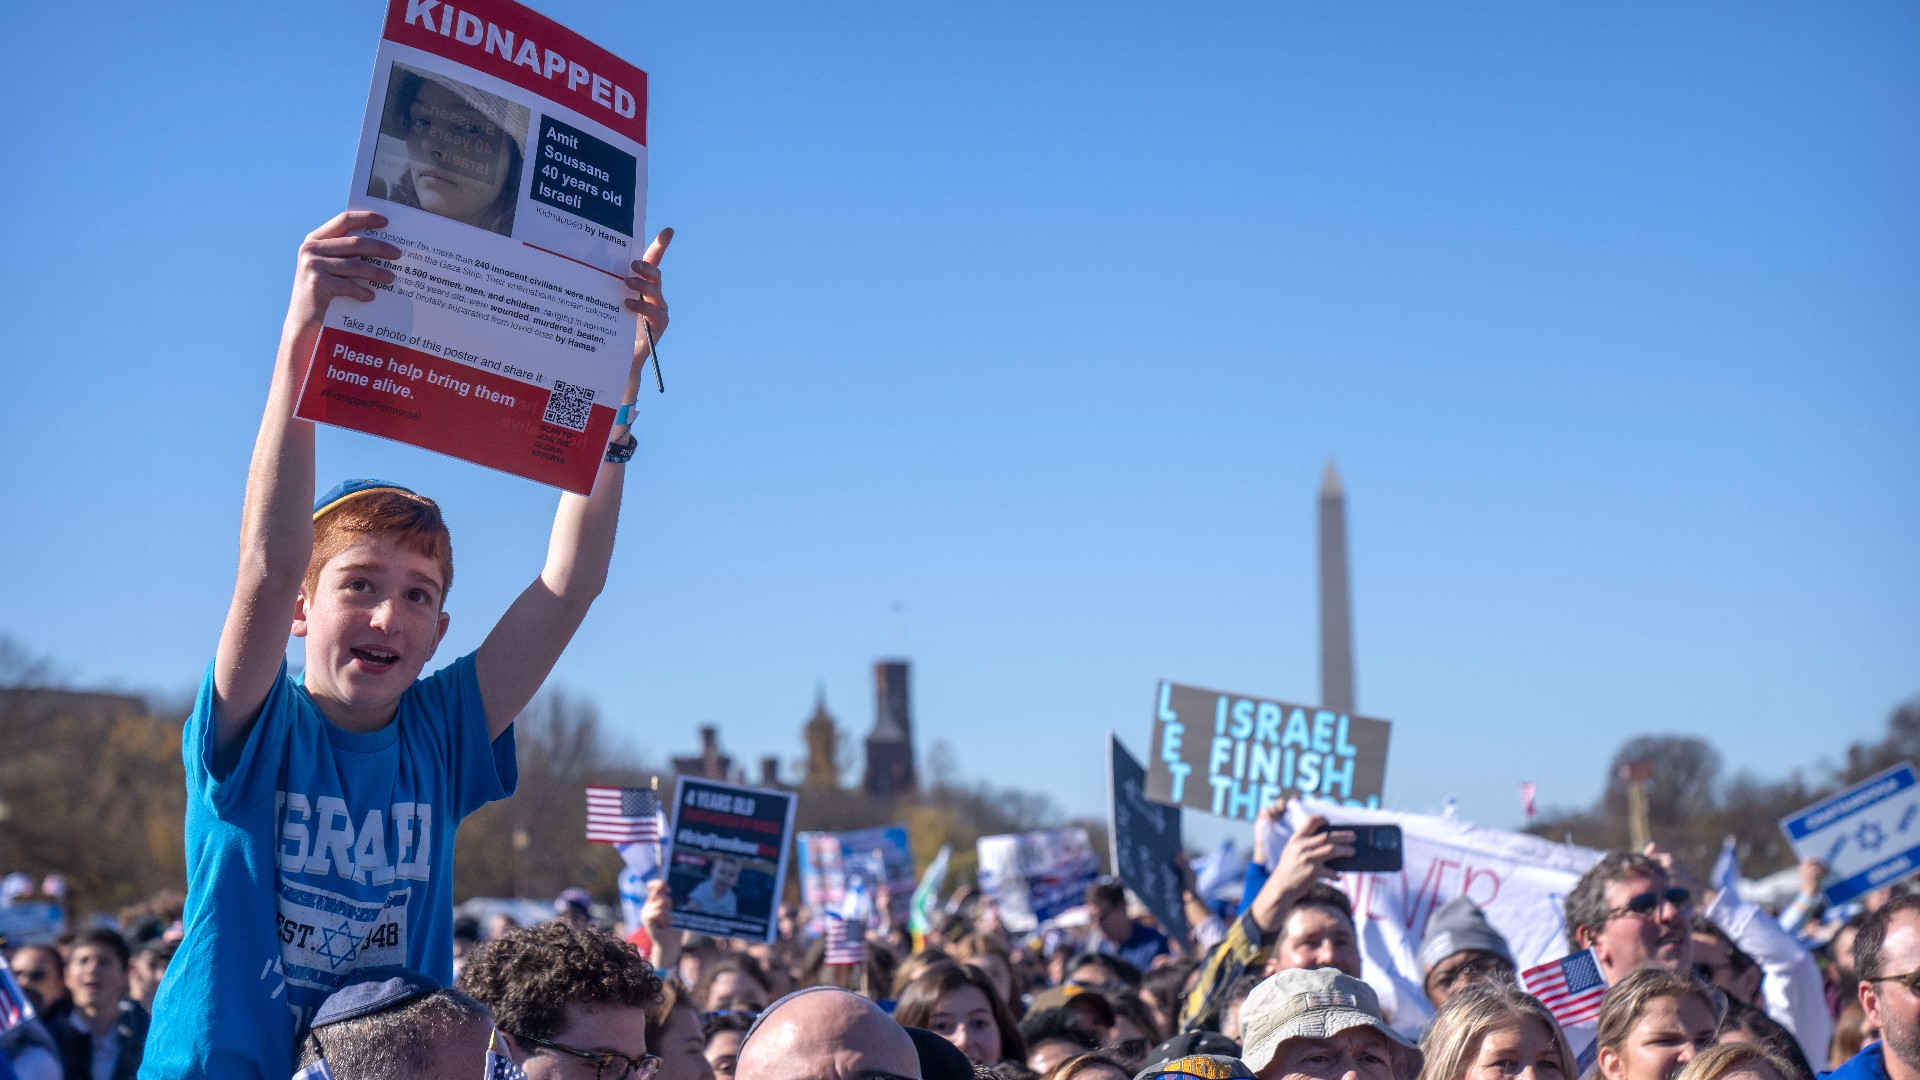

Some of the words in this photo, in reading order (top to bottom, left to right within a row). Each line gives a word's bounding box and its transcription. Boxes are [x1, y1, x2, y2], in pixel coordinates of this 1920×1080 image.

[404, 0, 637, 119] KIDNAPPED
[546, 126, 579, 150] Amit
[544, 144, 610, 183] Soussana
[538, 181, 582, 209] Israeli
[541, 164, 559, 180] 40
[562, 173, 599, 196] years
[602, 190, 622, 207] old
[536, 206, 583, 231] Kidnapped
[585, 224, 596, 236] by
[598, 228, 627, 248] Hamas
[364, 227, 378, 237] On
[380, 231, 415, 247] October
[432, 248, 454, 259] more
[455, 253, 473, 265] than
[474, 259, 490, 270] 240
[491, 265, 528, 282] innocent
[529, 276, 563, 293] civilians
[564, 288, 584, 300] were
[585, 295, 620, 313] abducted
[407, 251, 423, 261] into
[424, 256, 438, 266] the
[439, 260, 461, 273] Gaza
[486, 273, 506, 286] Their
[360, 255, 381, 266] More
[383, 260, 403, 272] than
[404, 266, 428, 279] 8,500
[429, 274, 463, 291] women,
[465, 285, 486, 298] men,
[487, 292, 505, 303] and
[544, 309, 574, 325] ranging
[404, 277, 413, 286] to
[427, 284, 450, 298] years
[469, 299, 489, 309] were
[398, 287, 414, 298] and
[415, 292, 447, 309] brutally
[448, 303, 490, 321] separated
[491, 314, 509, 327] from
[510, 321, 533, 334] loved
[555, 334, 566, 346] by
[342, 315, 365, 331] Take
[366, 325, 374, 333] a
[375, 326, 407, 343] photo
[409, 336, 422, 346] of
[422, 339, 442, 353] this
[443, 345, 479, 364] poster
[480, 357, 502, 371] and
[503, 364, 534, 380] share
[536, 372, 543, 384] it
[326, 364, 369, 387] home
[372, 378, 415, 400] alive.
[332, 343, 384, 369] Please
[387, 357, 423, 382] help
[426, 369, 471, 397] bring
[474, 383, 517, 408] them
[534, 441, 564, 455] GLOBAL
[537, 434, 555, 444] JOIN
[557, 439, 571, 448] THE
[540, 424, 561, 436] SCAN
[563, 430, 573, 439] TO
[531, 449, 566, 464] EFFORTS
[1214, 694, 1357, 758] ISRAEL
[1208, 736, 1355, 798] FINISH
[1208, 774, 1282, 821] THE
[361, 922, 399, 950] 48
